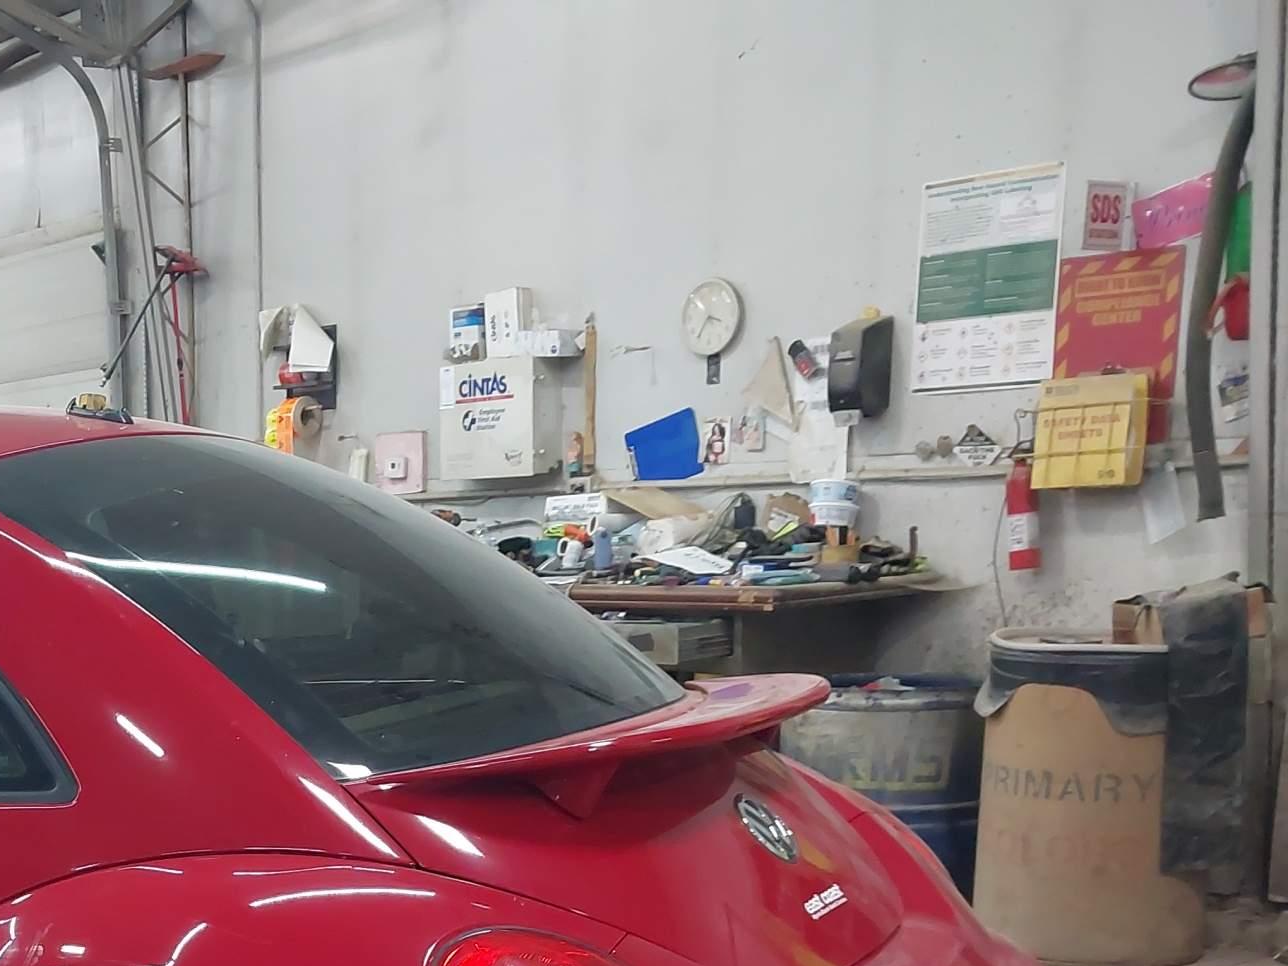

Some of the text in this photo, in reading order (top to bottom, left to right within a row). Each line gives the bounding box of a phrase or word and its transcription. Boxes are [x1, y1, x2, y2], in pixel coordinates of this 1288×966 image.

[1090, 193, 1121, 224] SDS
[459, 371, 507, 398] CINTAS
[983, 763, 1157, 803] PRIMARY
